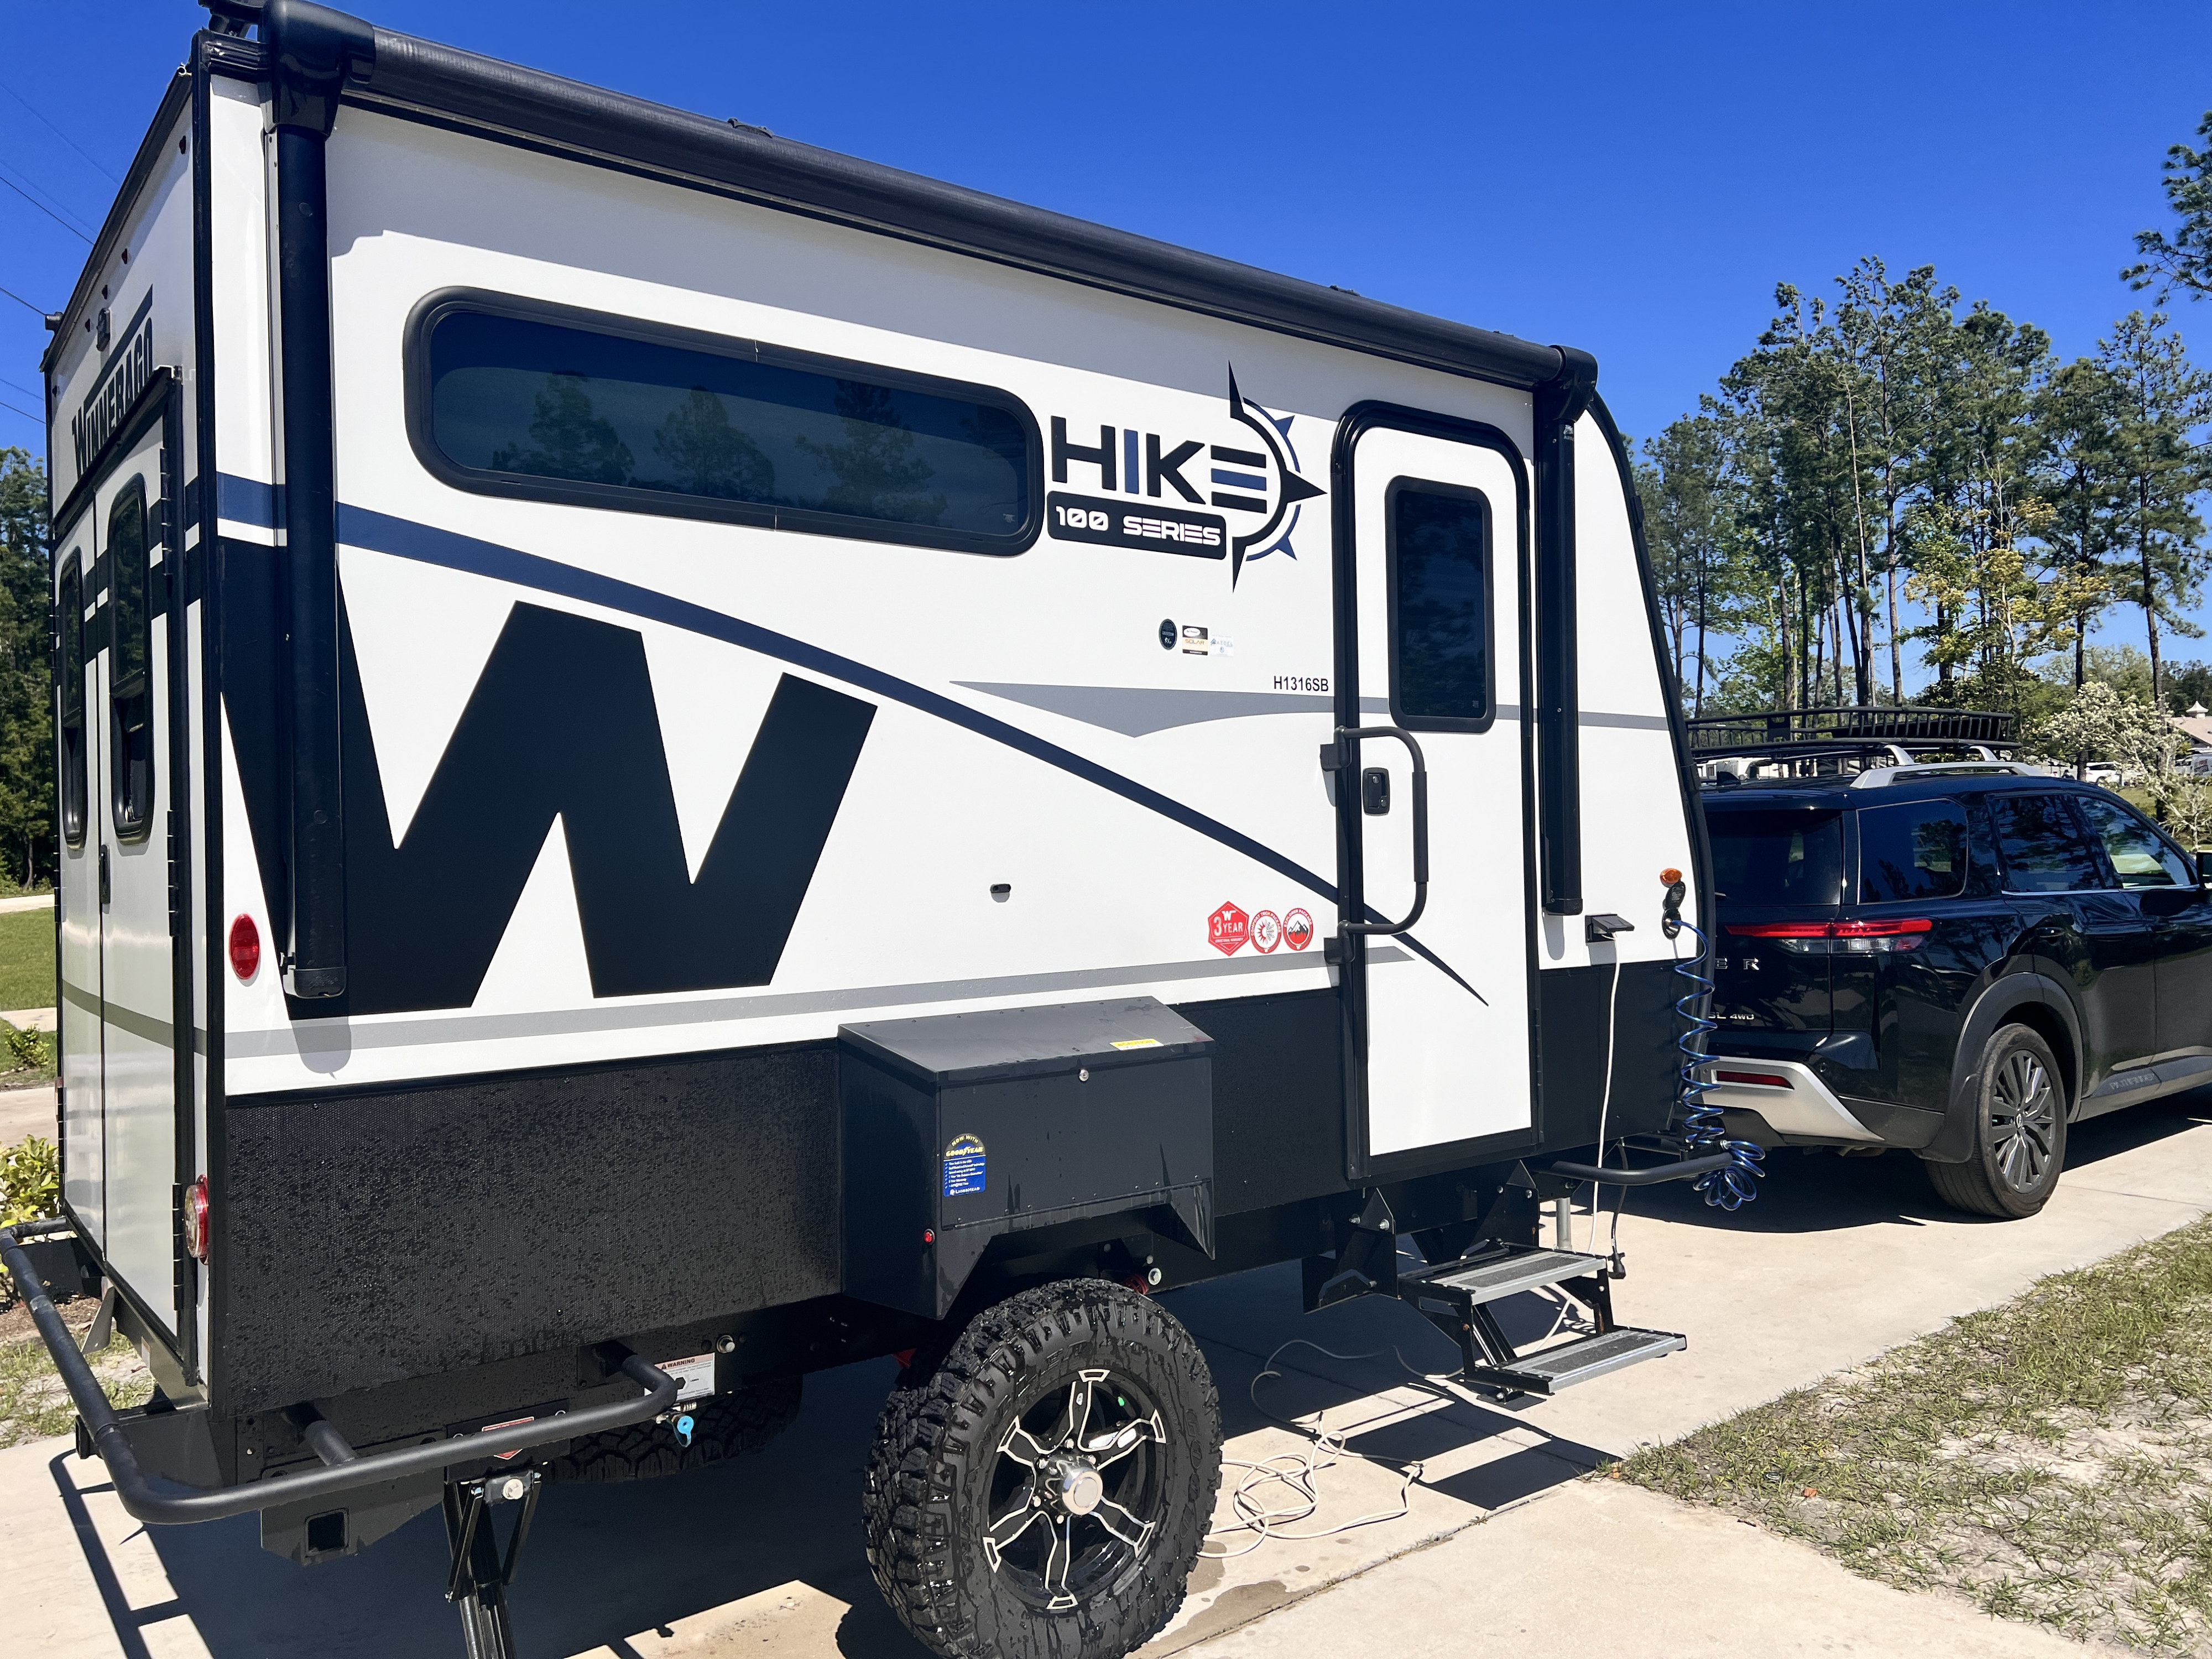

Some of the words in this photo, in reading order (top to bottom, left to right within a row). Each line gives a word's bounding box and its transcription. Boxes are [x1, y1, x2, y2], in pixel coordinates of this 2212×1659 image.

[72, 284, 153, 481] WINNEBAGO
[1051, 415, 1267, 514] HIKE
[1056, 505, 1109, 531] 100
[1123, 517, 1221, 546] SERIES
[1274, 676, 1329, 692] H1316SB
[1298, 909, 1313, 925] PACKAGE
[1213, 916, 1222, 936] 3
[1223, 922, 1243, 933] YEAR
[951, 1135, 964, 1146] NOW
[966, 1135, 979, 1144] WITH
[946, 1146, 983, 1156] GOODYEAR
[667, 1358, 695, 1368] WARNING
